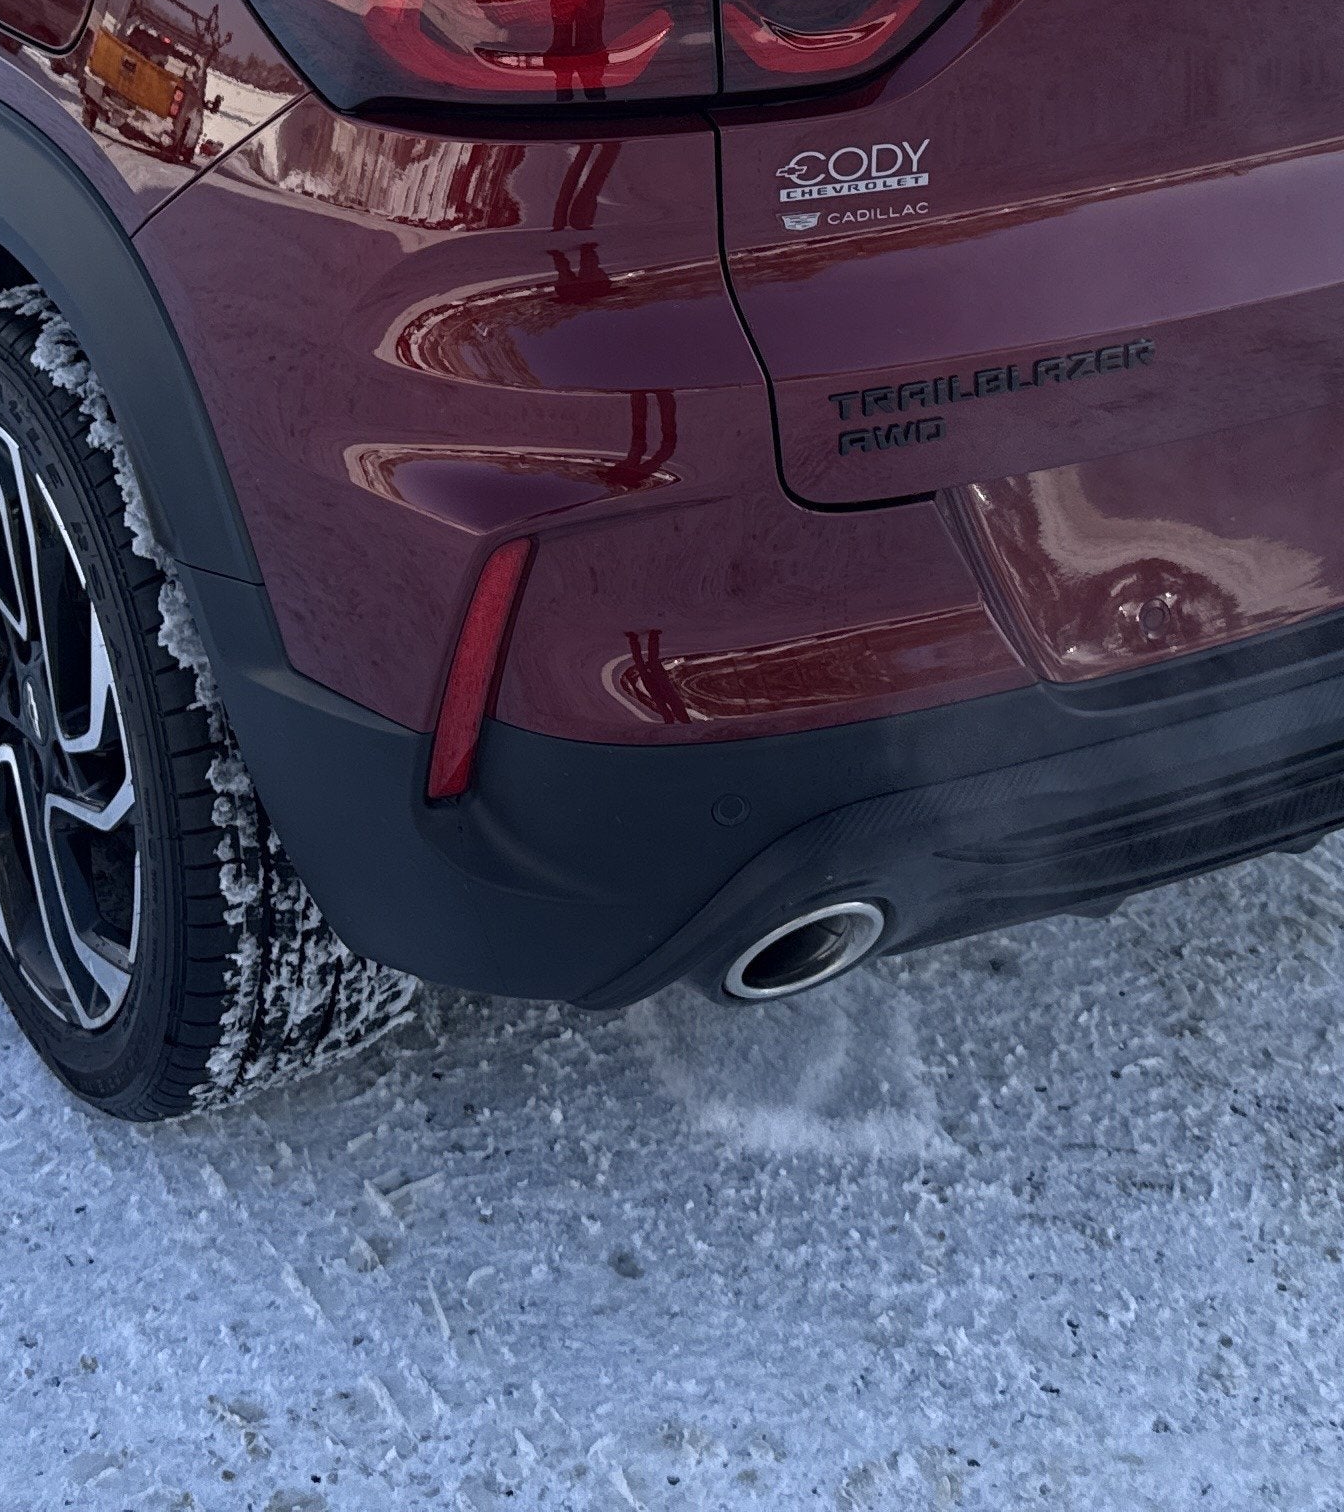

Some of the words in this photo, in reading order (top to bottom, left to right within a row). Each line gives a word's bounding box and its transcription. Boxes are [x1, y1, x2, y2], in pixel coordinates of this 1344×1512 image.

[782, 138, 931, 186] CODY
[785, 174, 924, 200] CHEVROLET
[827, 201, 930, 225] CADILLAC
[828, 337, 1156, 421] TRAILBLAZER
[837, 416, 946, 457] AWD
